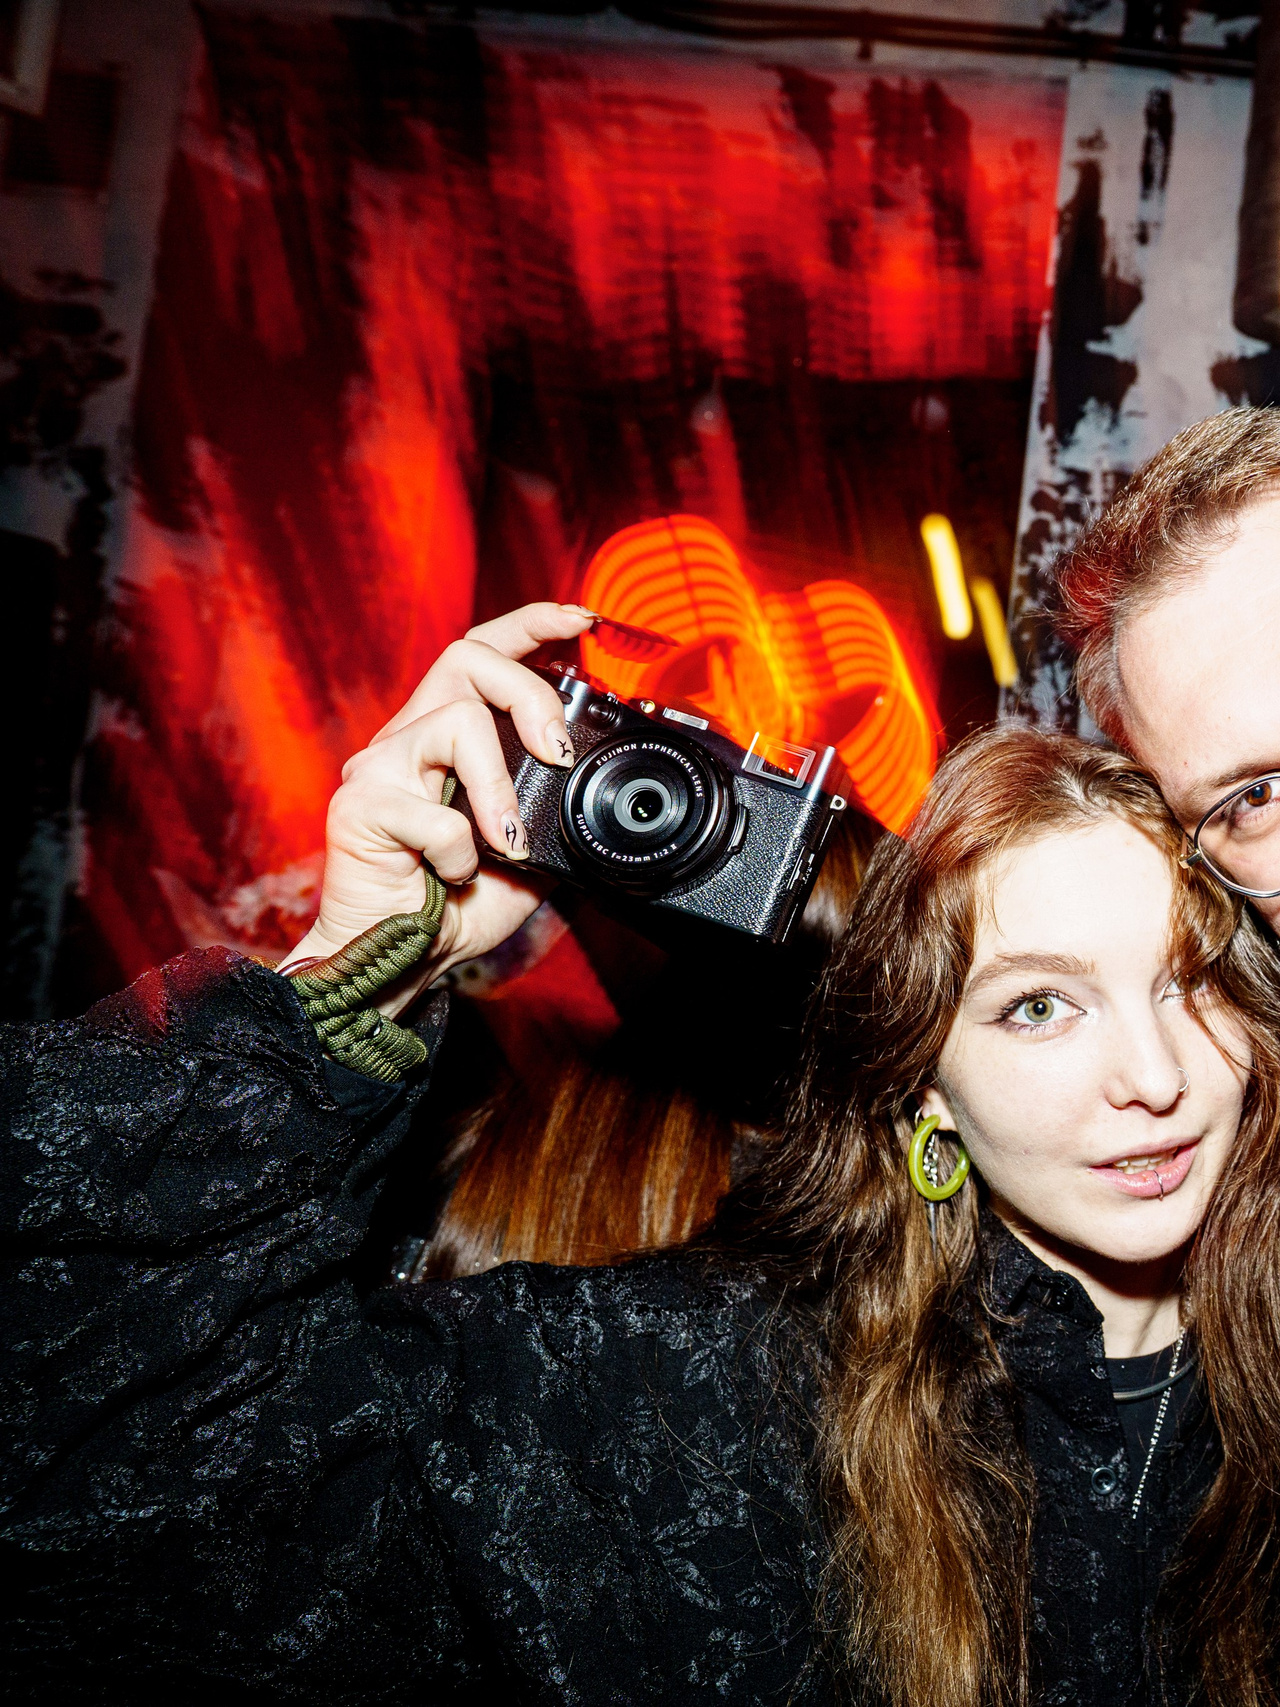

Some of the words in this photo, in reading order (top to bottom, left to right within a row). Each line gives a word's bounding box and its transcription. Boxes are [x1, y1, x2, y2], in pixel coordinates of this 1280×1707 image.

[595, 743, 637, 767] FUJINON
[641, 742, 694, 773] ASPHERICAL
[691, 774, 704, 798] LENS
[576, 813, 594, 842] SUPER
[591, 840, 610, 856] EBC
[610, 851, 651, 863] f=23mm
[653, 847, 669, 859] 1:2
